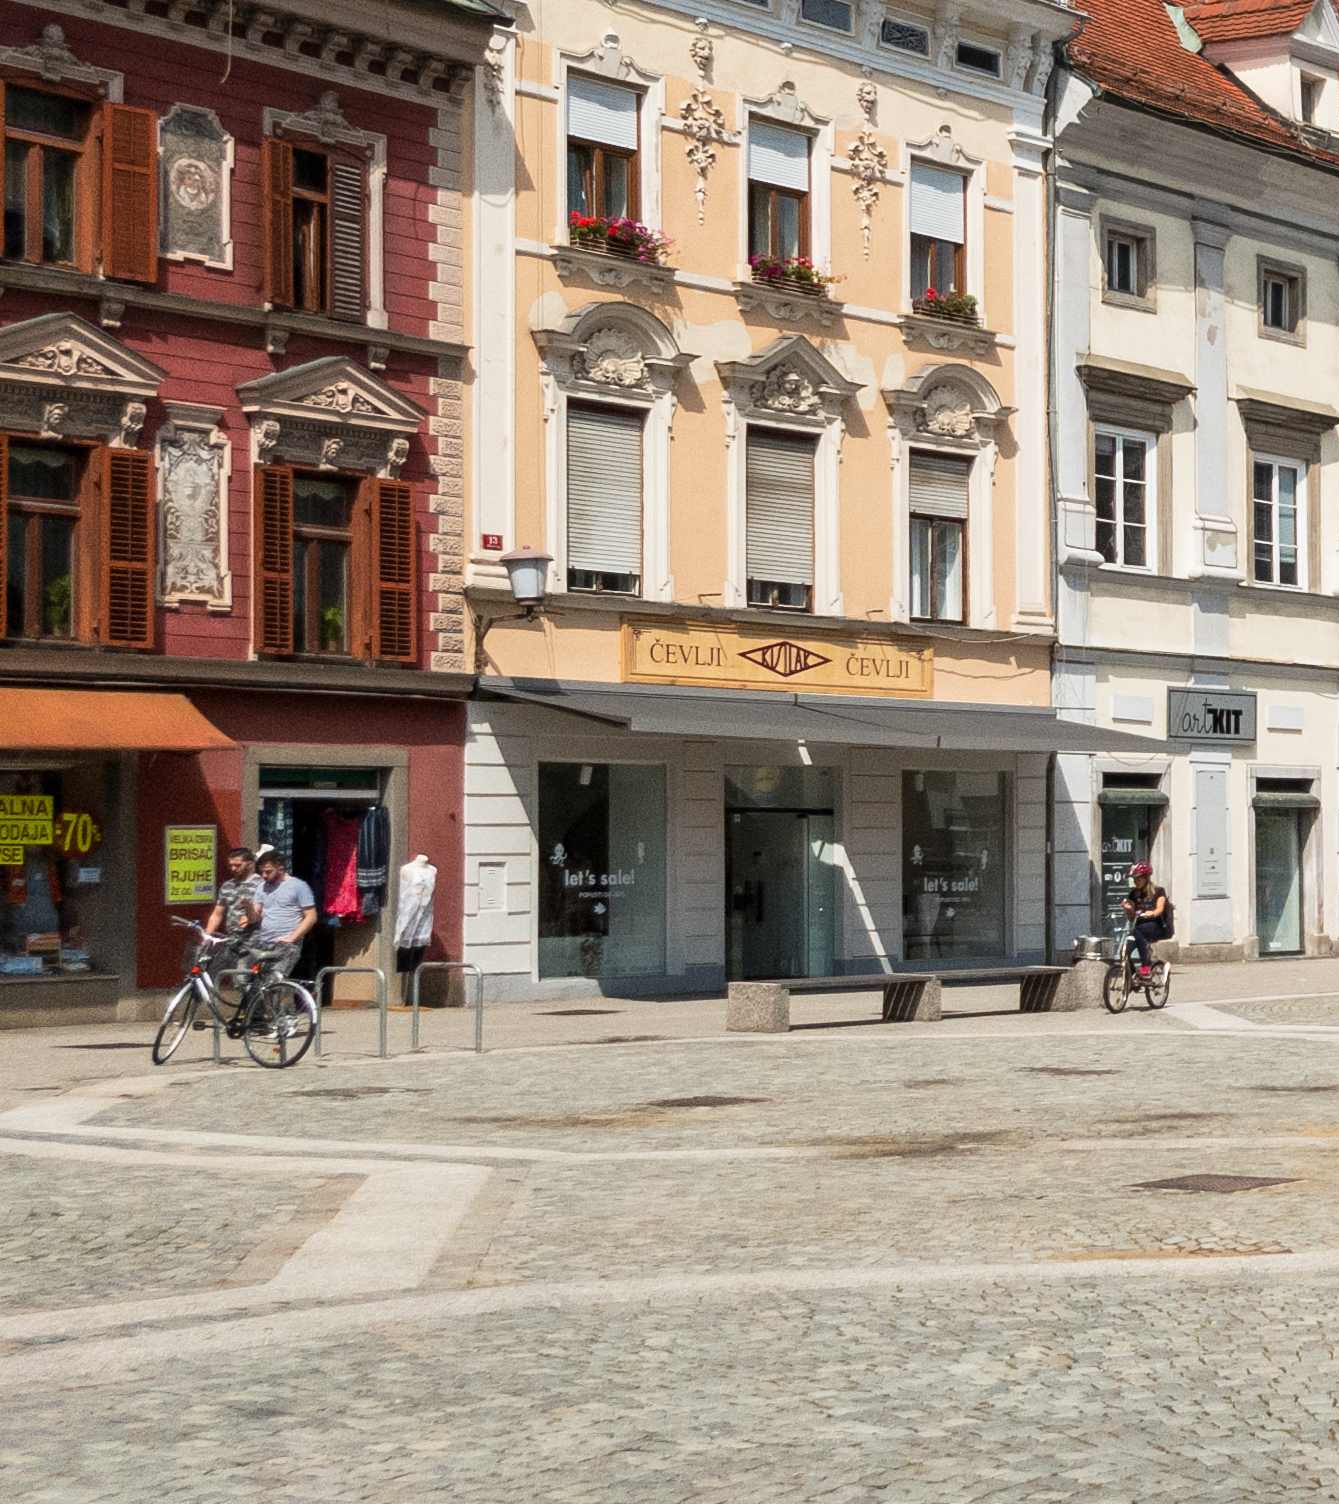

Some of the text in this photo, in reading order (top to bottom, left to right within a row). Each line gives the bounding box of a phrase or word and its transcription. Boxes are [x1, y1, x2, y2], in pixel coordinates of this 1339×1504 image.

[650, 638, 721, 667] ČEVLJI
[846, 653, 910, 679] ČEVLJI
[1182, 697, 1243, 735] artKIT
[170, 845, 213, 860] BRISAČ
[171, 870, 212, 882] RJUHE
[564, 869, 635, 886] let's sale!
[923, 877, 979, 892] let's sale!
